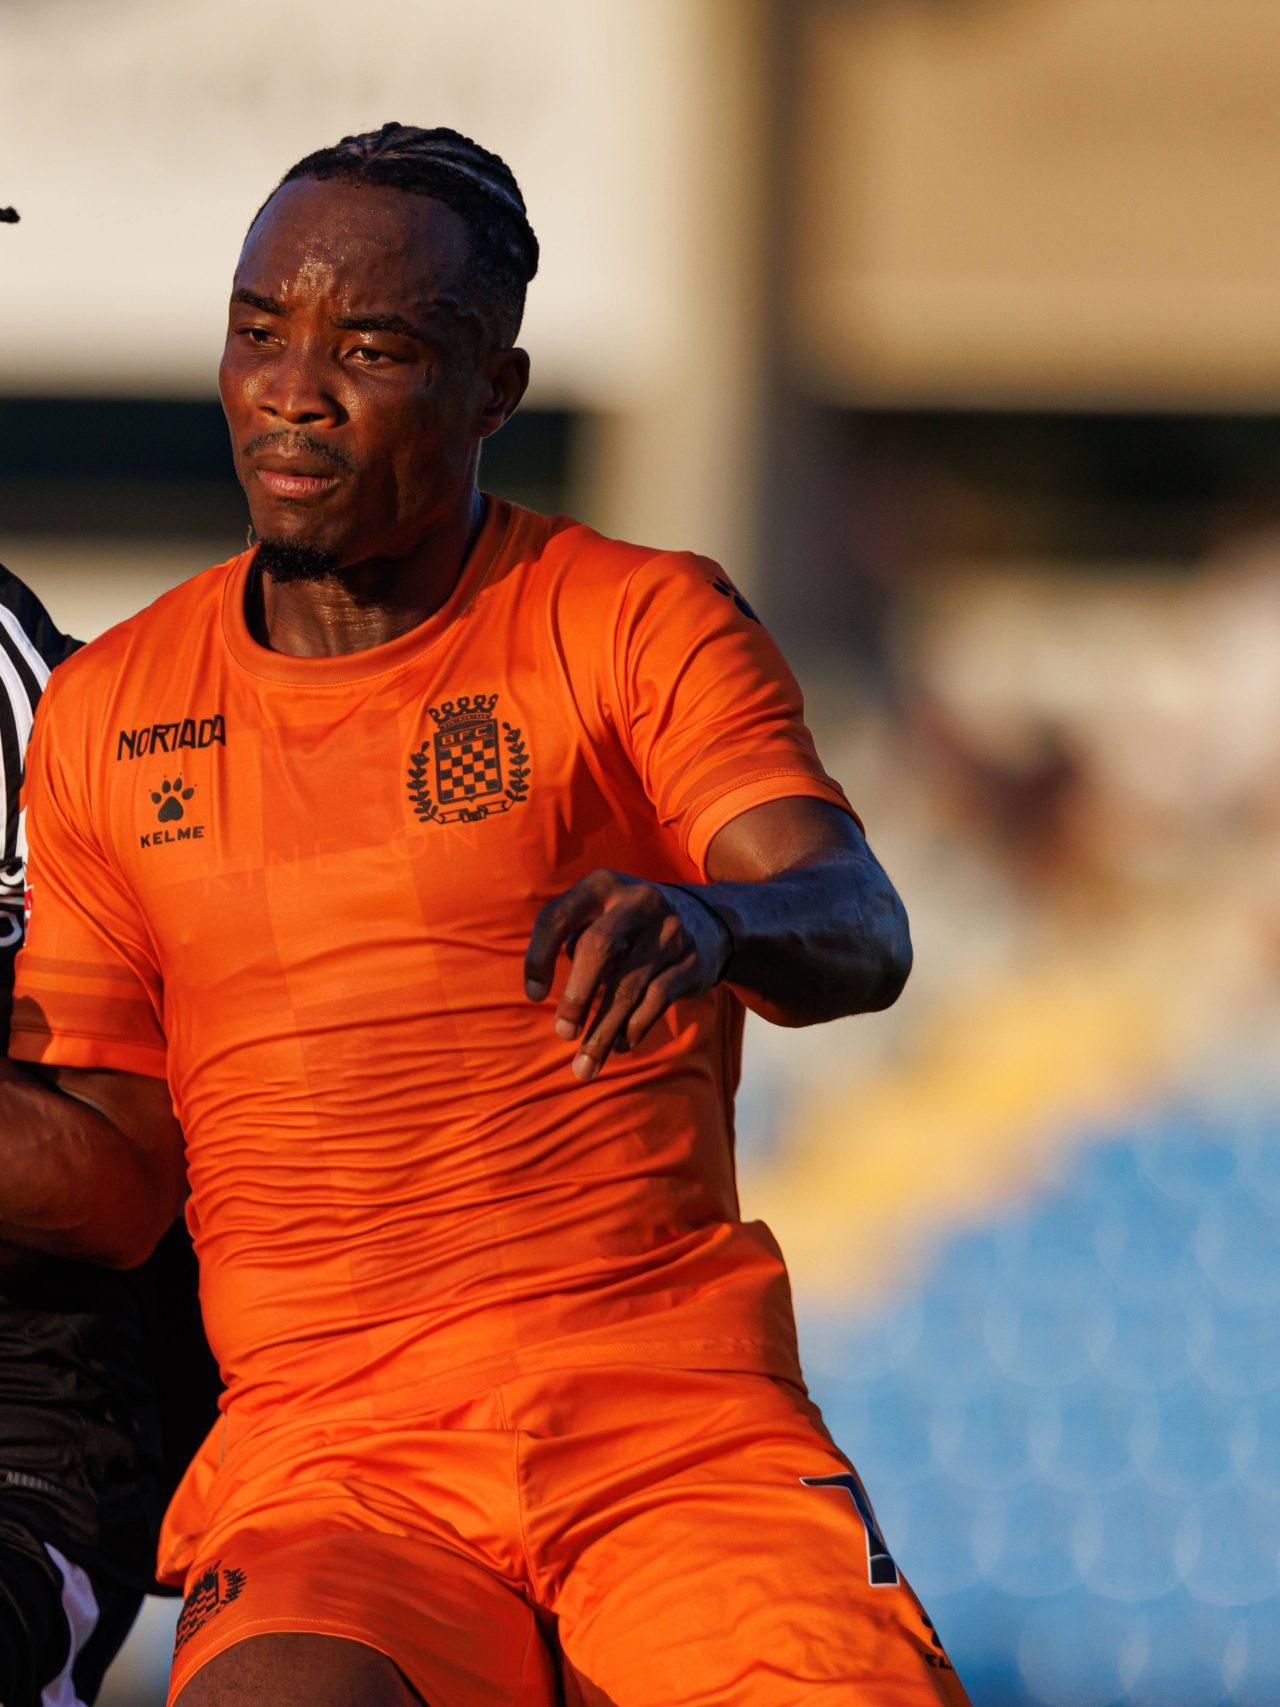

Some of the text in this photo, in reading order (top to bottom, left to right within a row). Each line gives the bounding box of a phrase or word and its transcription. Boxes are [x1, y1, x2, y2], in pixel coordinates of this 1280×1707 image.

[117, 714, 226, 761] NORTADA
[441, 726, 488, 746] BFC
[140, 825, 205, 849] KELME
